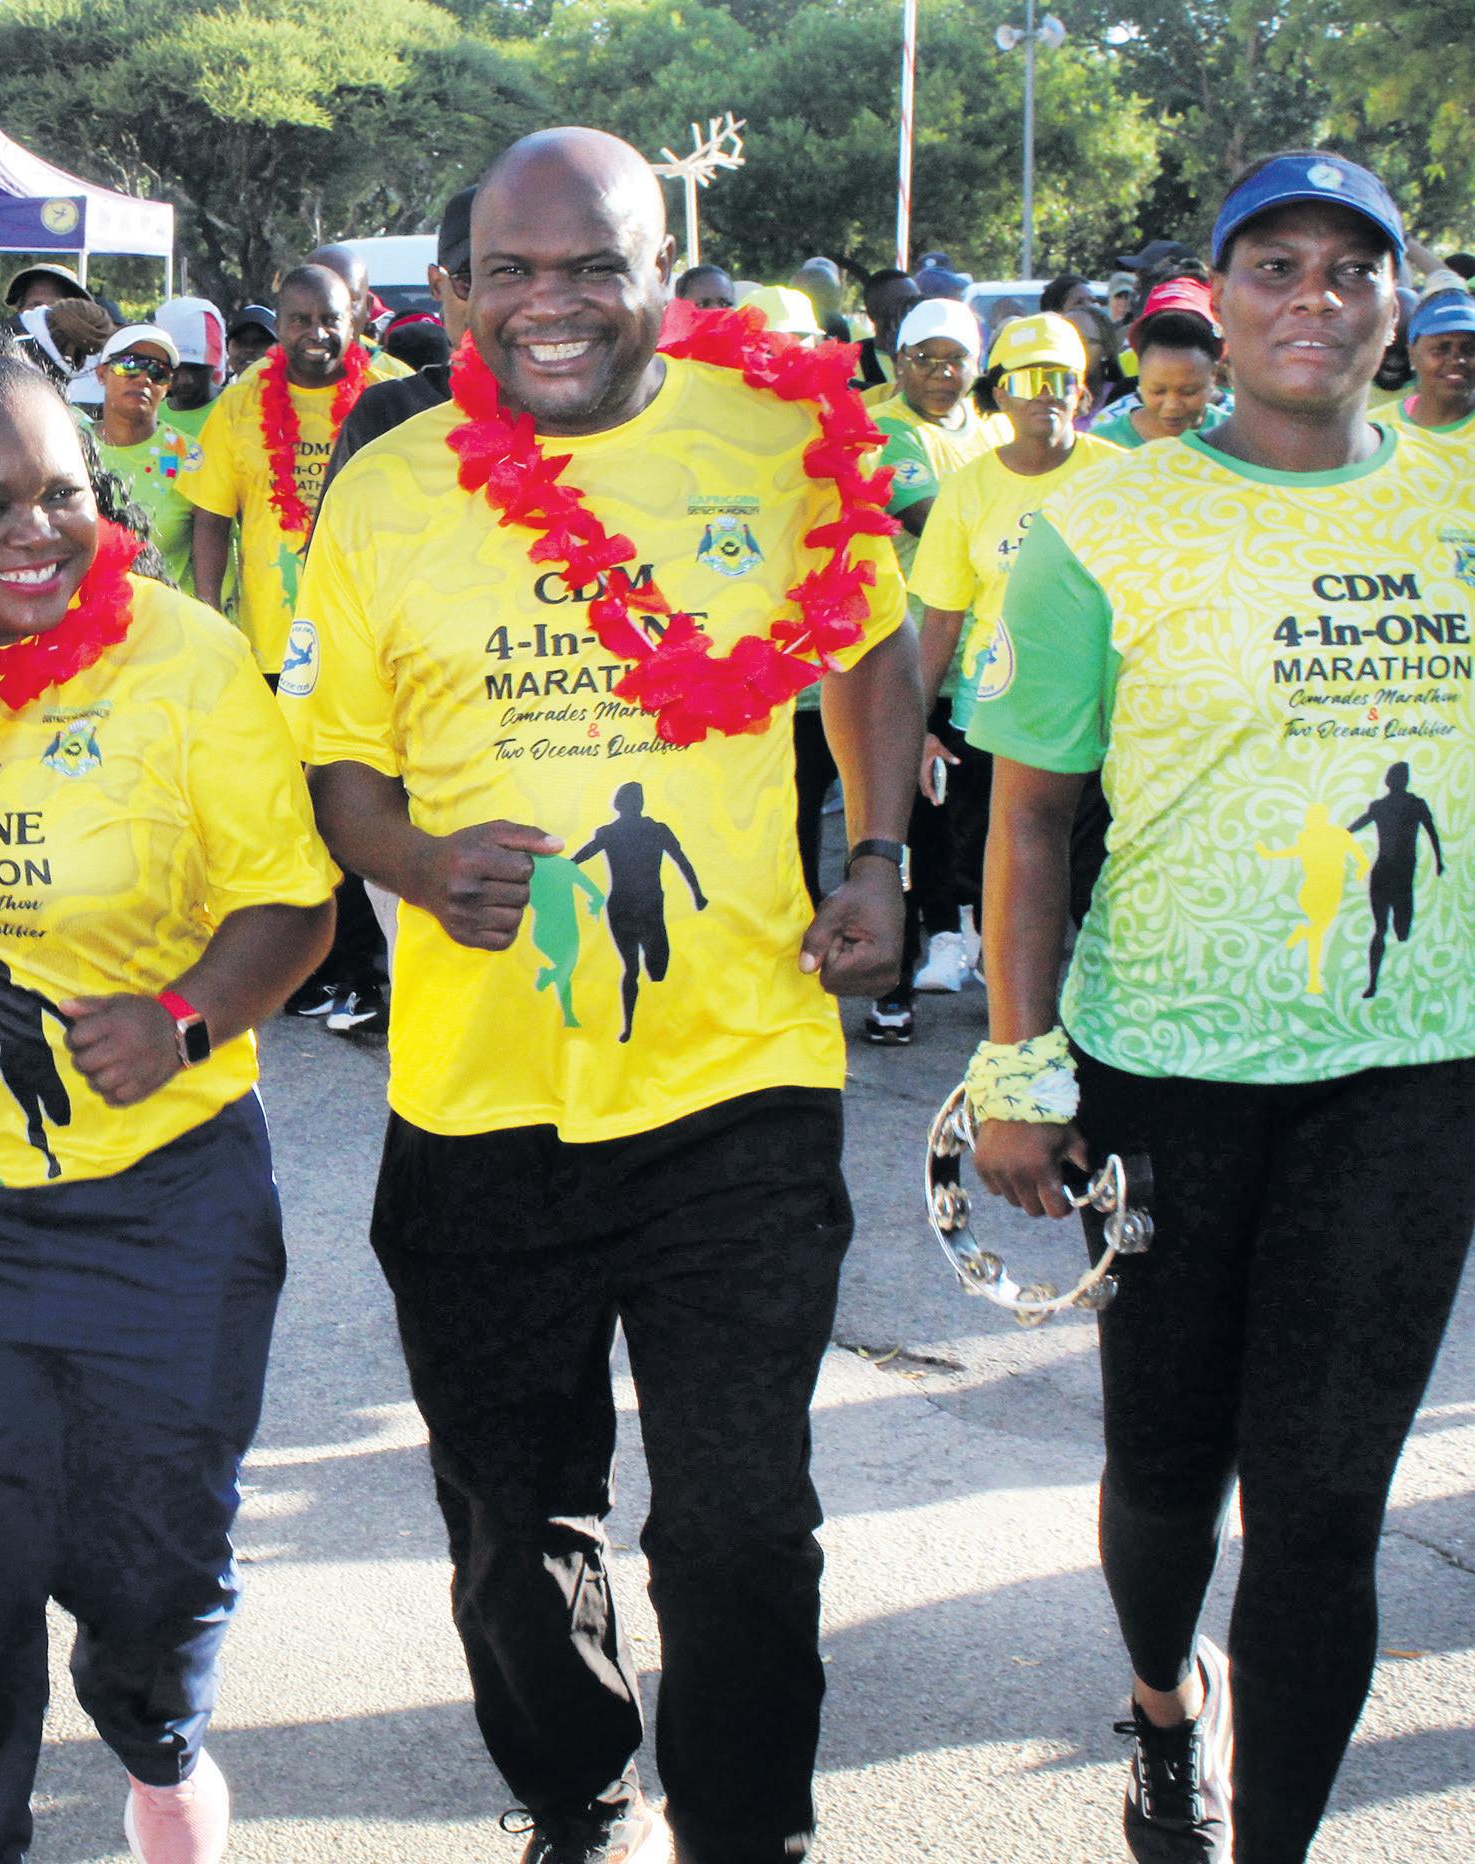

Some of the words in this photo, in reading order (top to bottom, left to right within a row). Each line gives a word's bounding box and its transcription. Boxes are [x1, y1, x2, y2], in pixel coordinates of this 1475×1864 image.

[1312, 574, 1422, 602] CDM
[1273, 613, 1471, 647] 4-In-ONE
[1273, 655, 1472, 684] MARATHON
[485, 664, 630, 700] MARAT
[1289, 688, 1370, 708] Comrades
[501, 702, 586, 727] Comrades
[1367, 707, 1379, 721] &
[586, 723, 601, 738] &
[1283, 718, 1312, 738] Two
[1317, 719, 1380, 740] Oceans
[1383, 718, 1457, 738] Qualifier
[493, 738, 524, 760] Two
[530, 739, 601, 760] Oceans
